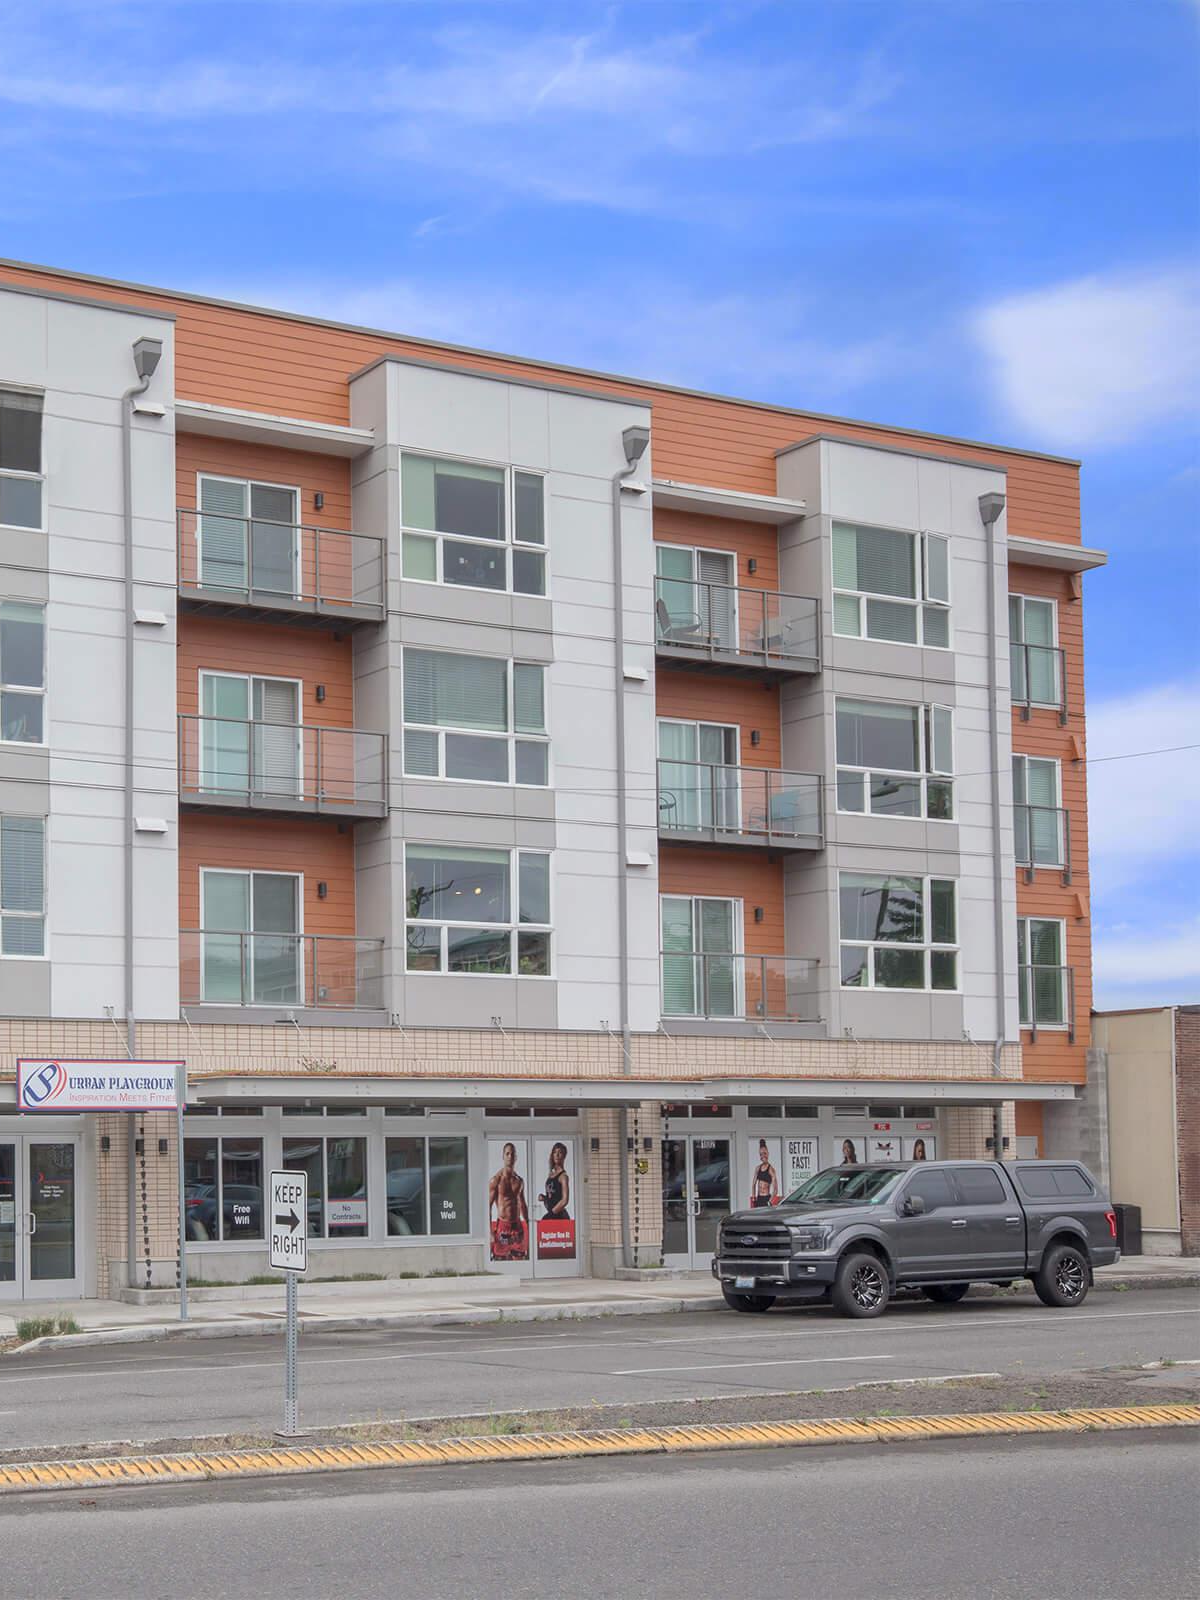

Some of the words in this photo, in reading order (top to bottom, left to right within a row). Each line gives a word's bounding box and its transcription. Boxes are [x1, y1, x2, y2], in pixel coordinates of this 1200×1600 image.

[69, 1077, 106, 1090] URBAN
[109, 1077, 175, 1091] PLAYGROUN
[69, 1093, 117, 1102] INSPIRATION
[119, 1092, 147, 1102] MEETS
[789, 1141, 801, 1154] GET
[802, 1141, 812, 1154] FIT
[791, 1156, 811, 1169] FAST!
[274, 1184, 303, 1204] KEEP
[232, 1204, 251, 1214] Free
[442, 1200, 454, 1209] Be
[331, 1213, 362, 1221] Contracts
[440, 1211, 457, 1220] Well
[273, 1234, 305, 1255] RIGHT
